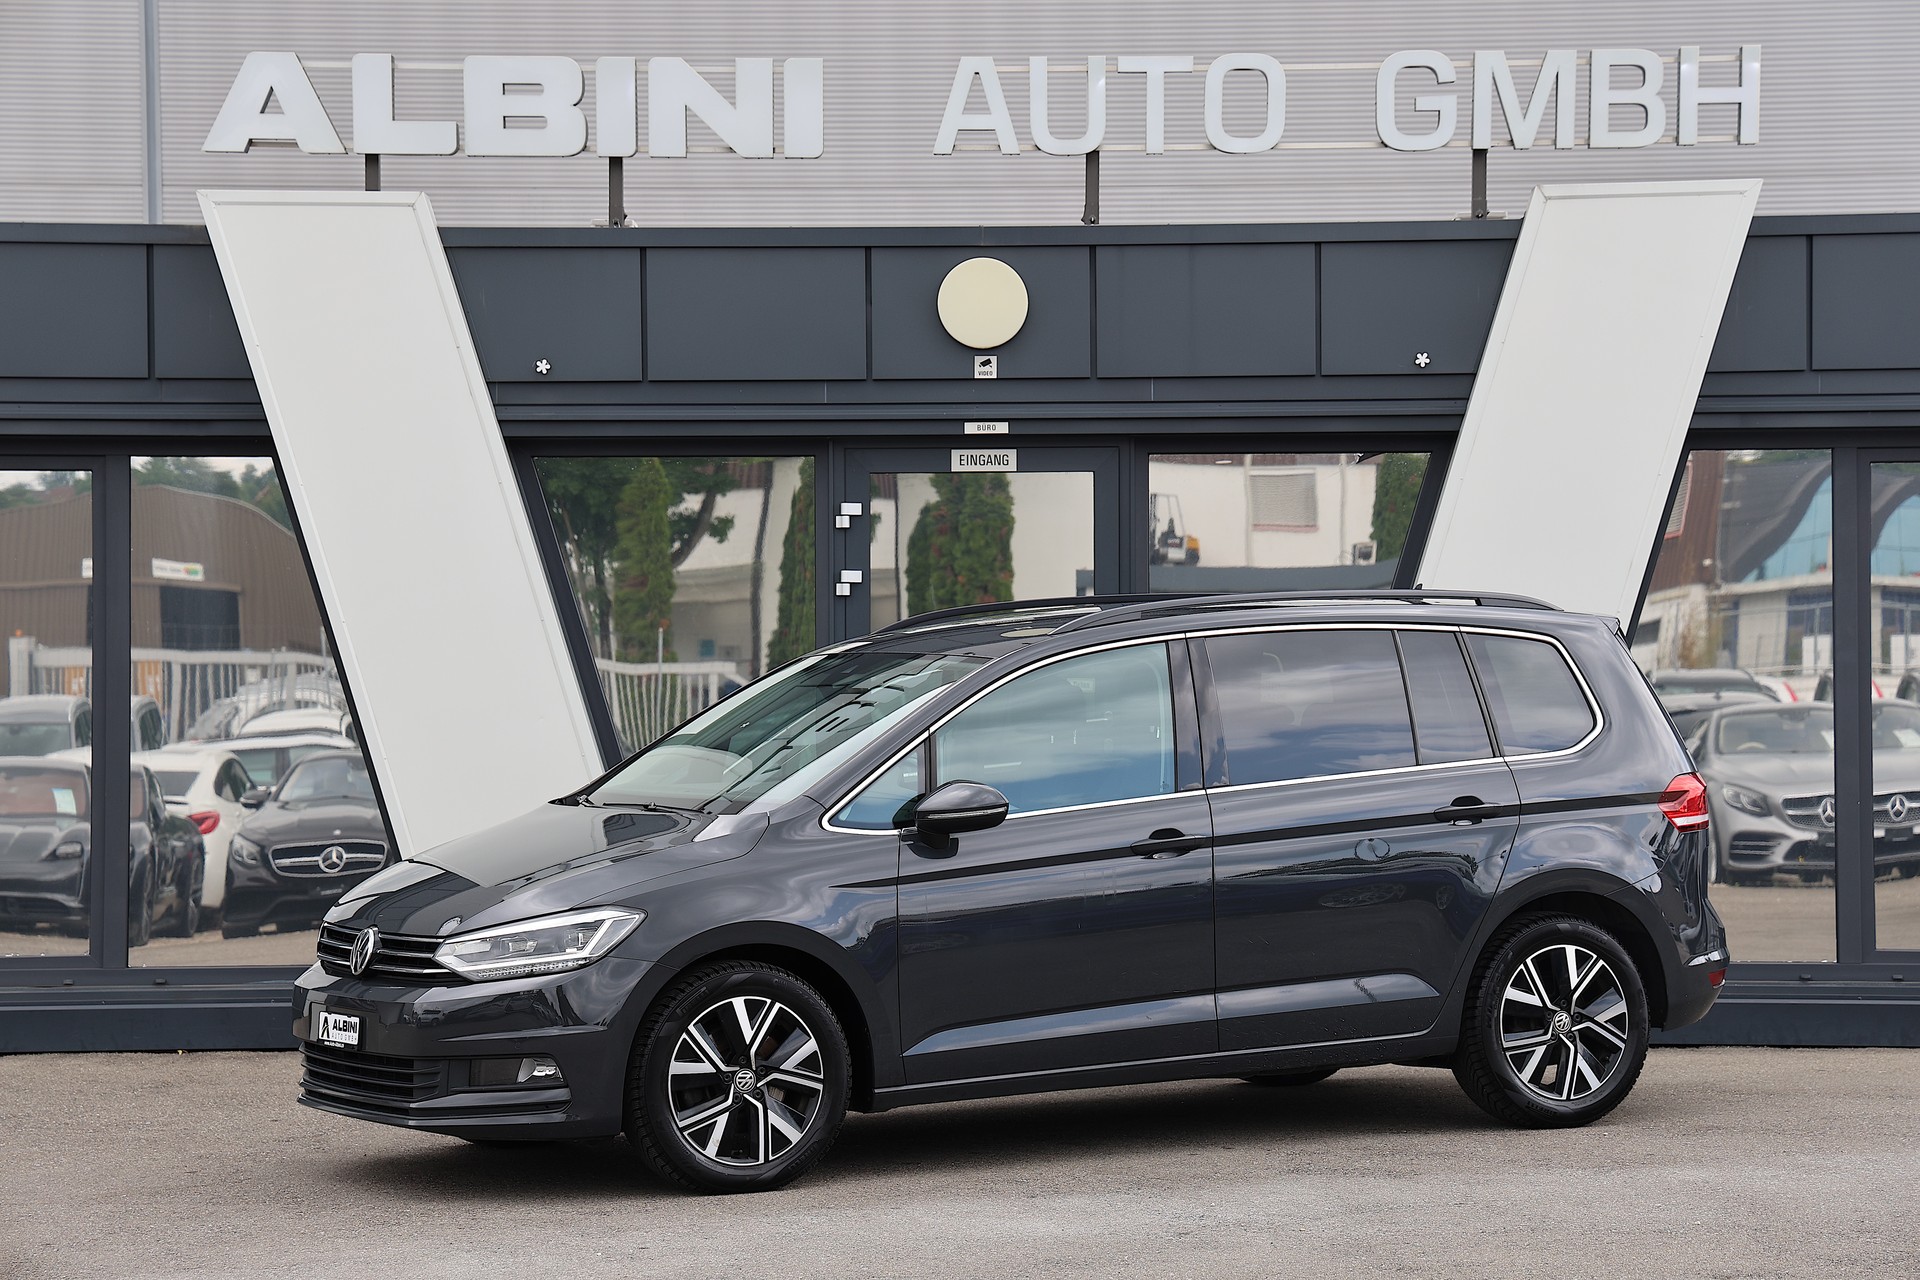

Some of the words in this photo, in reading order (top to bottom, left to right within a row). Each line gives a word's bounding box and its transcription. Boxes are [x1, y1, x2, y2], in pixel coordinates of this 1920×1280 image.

[201, 51, 825, 159] ALBINI
[933, 53, 1286, 156] AUTO
[1375, 44, 1762, 154] GMBH
[977, 423, 997, 431] BÜRO
[959, 454, 1009, 466] EINGANG
[332, 1018, 358, 1034] ALBINI
